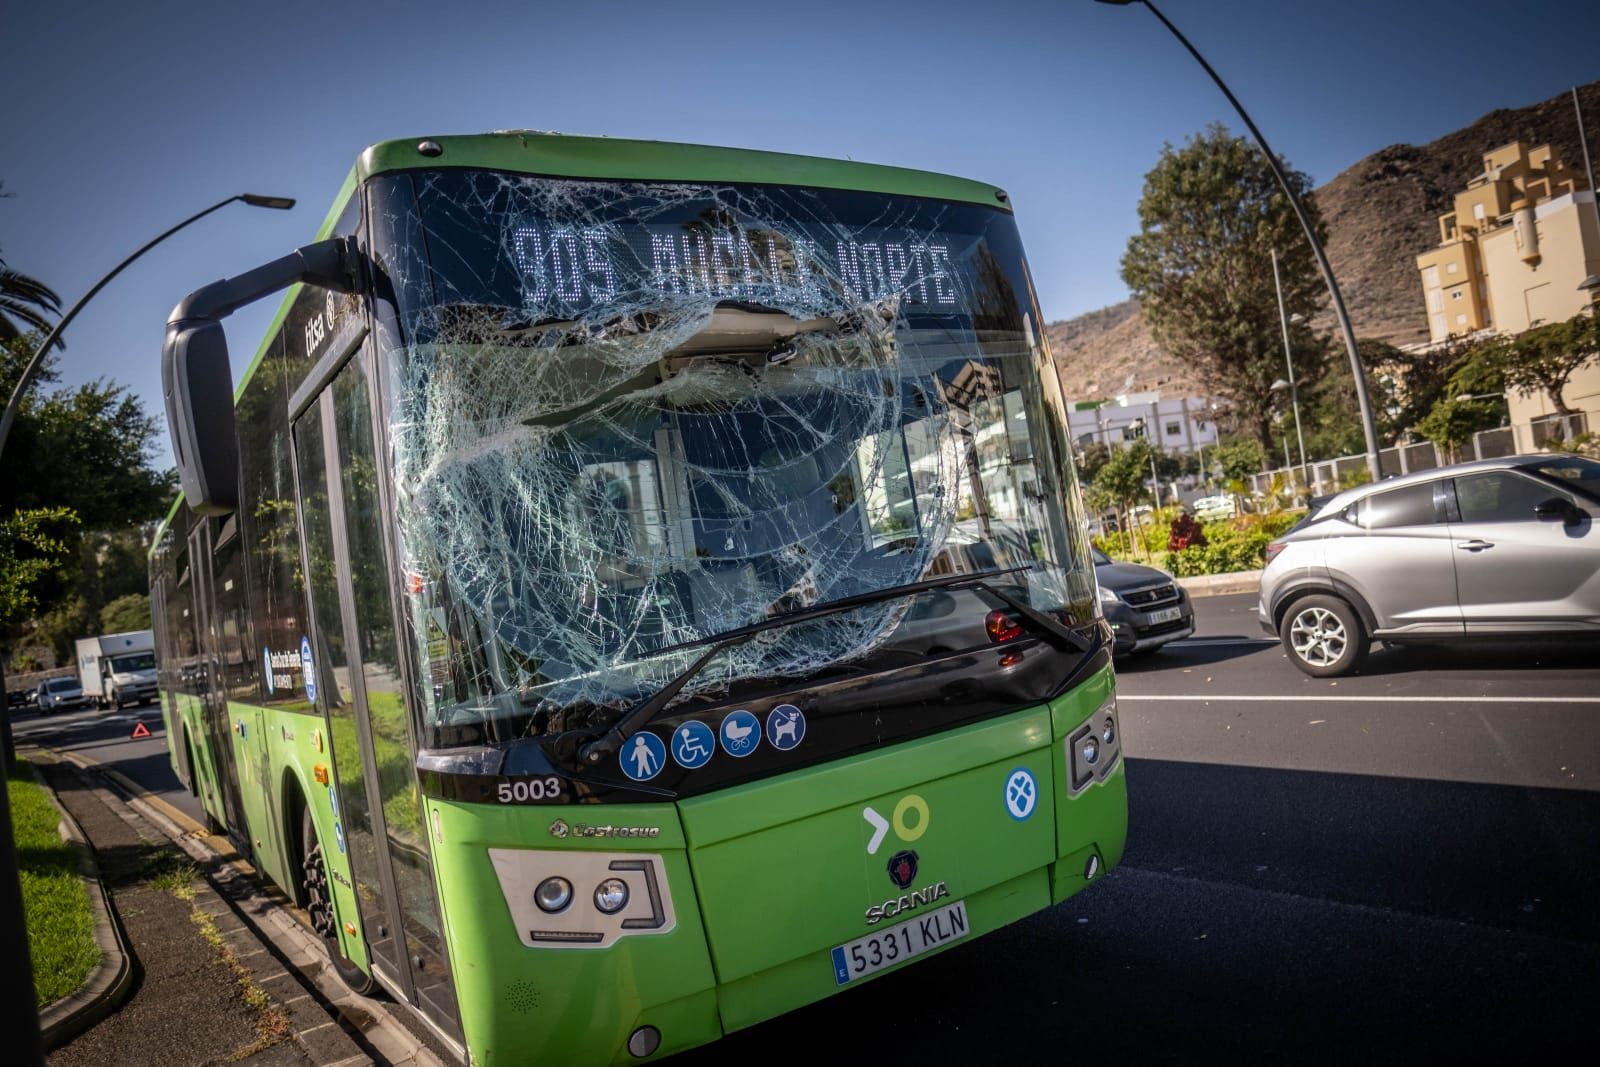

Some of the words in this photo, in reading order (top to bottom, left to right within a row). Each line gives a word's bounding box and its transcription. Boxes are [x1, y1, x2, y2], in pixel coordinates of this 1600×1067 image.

[515, 227, 615, 303] 905
[837, 241, 955, 304] NORTE
[305, 312, 324, 357] titsa
[498, 777, 561, 803] 5003
[865, 881, 950, 925] SCANIA
[851, 927, 913, 973] 5331
[920, 905, 966, 947] KLN
